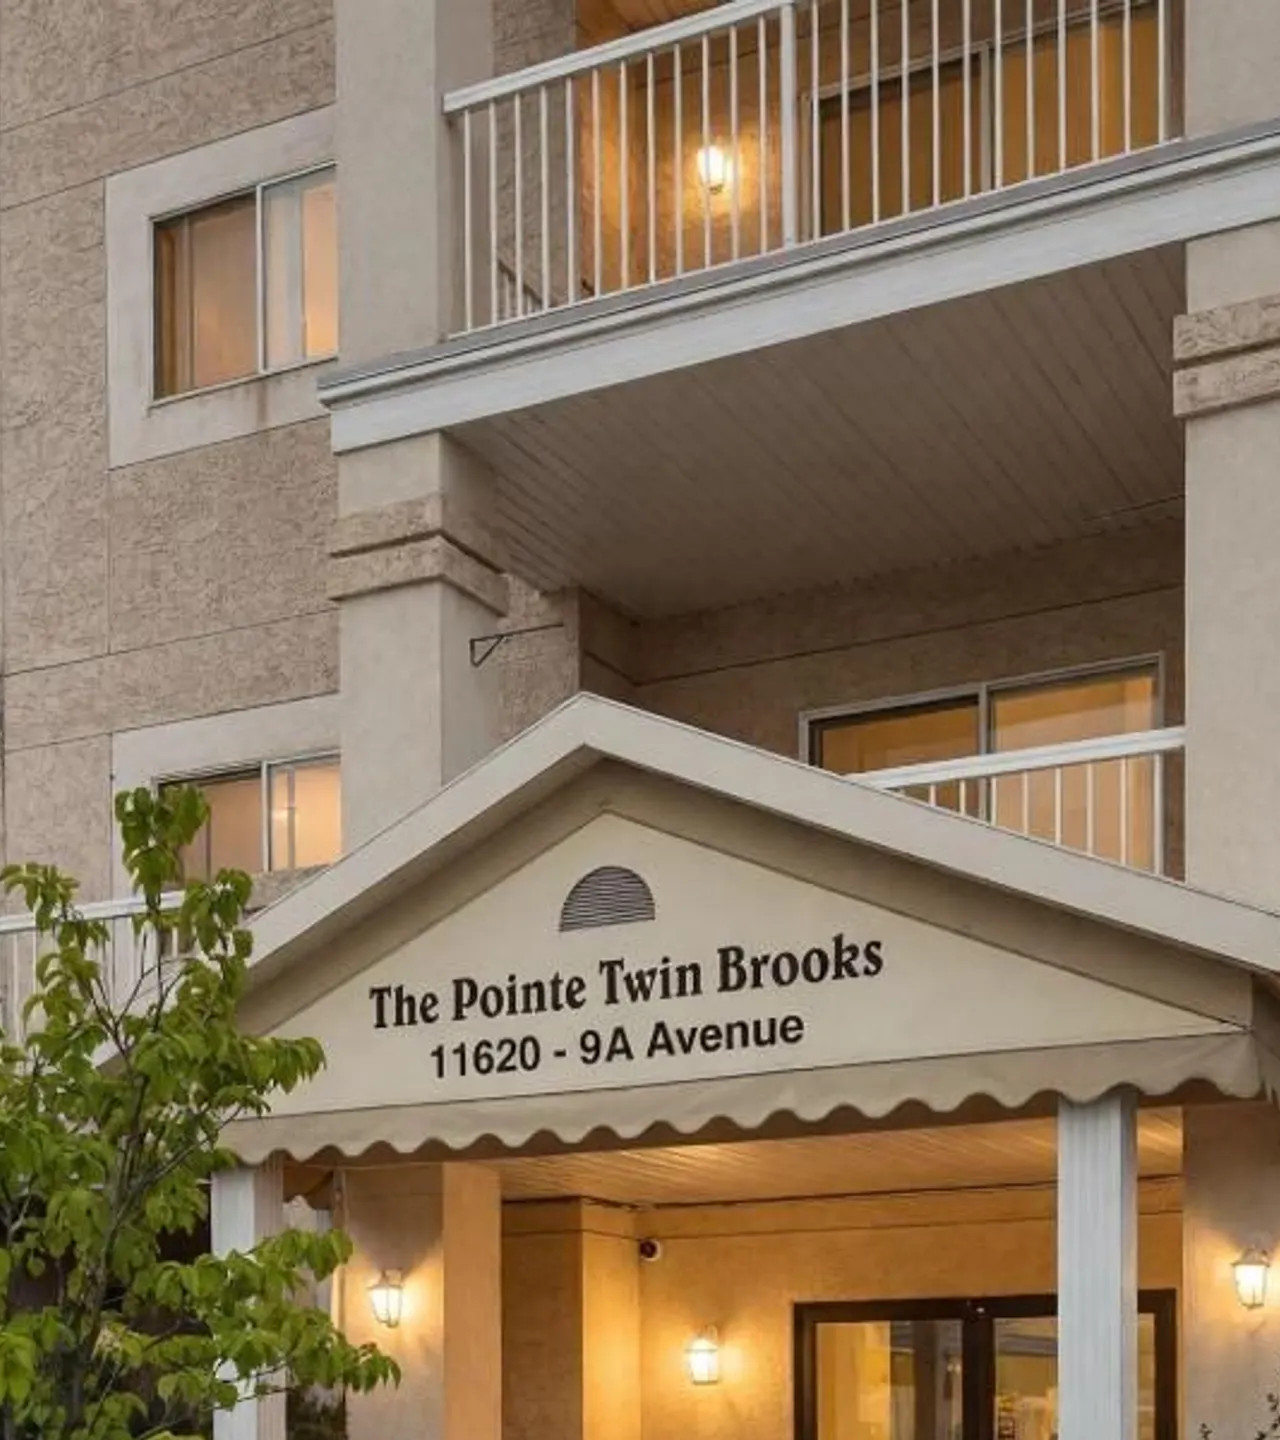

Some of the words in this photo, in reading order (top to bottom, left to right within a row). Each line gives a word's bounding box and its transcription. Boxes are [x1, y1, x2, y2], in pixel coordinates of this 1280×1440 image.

[369, 983, 440, 1029] The
[451, 971, 587, 1021] Pointe
[598, 956, 703, 1006] Twin
[717, 933, 884, 993] Brooks
[430, 1035, 542, 1079] 11620
[553, 1049, 567, 1058] -
[579, 1025, 635, 1065] 9A
[646, 1014, 806, 1059] Avenue
